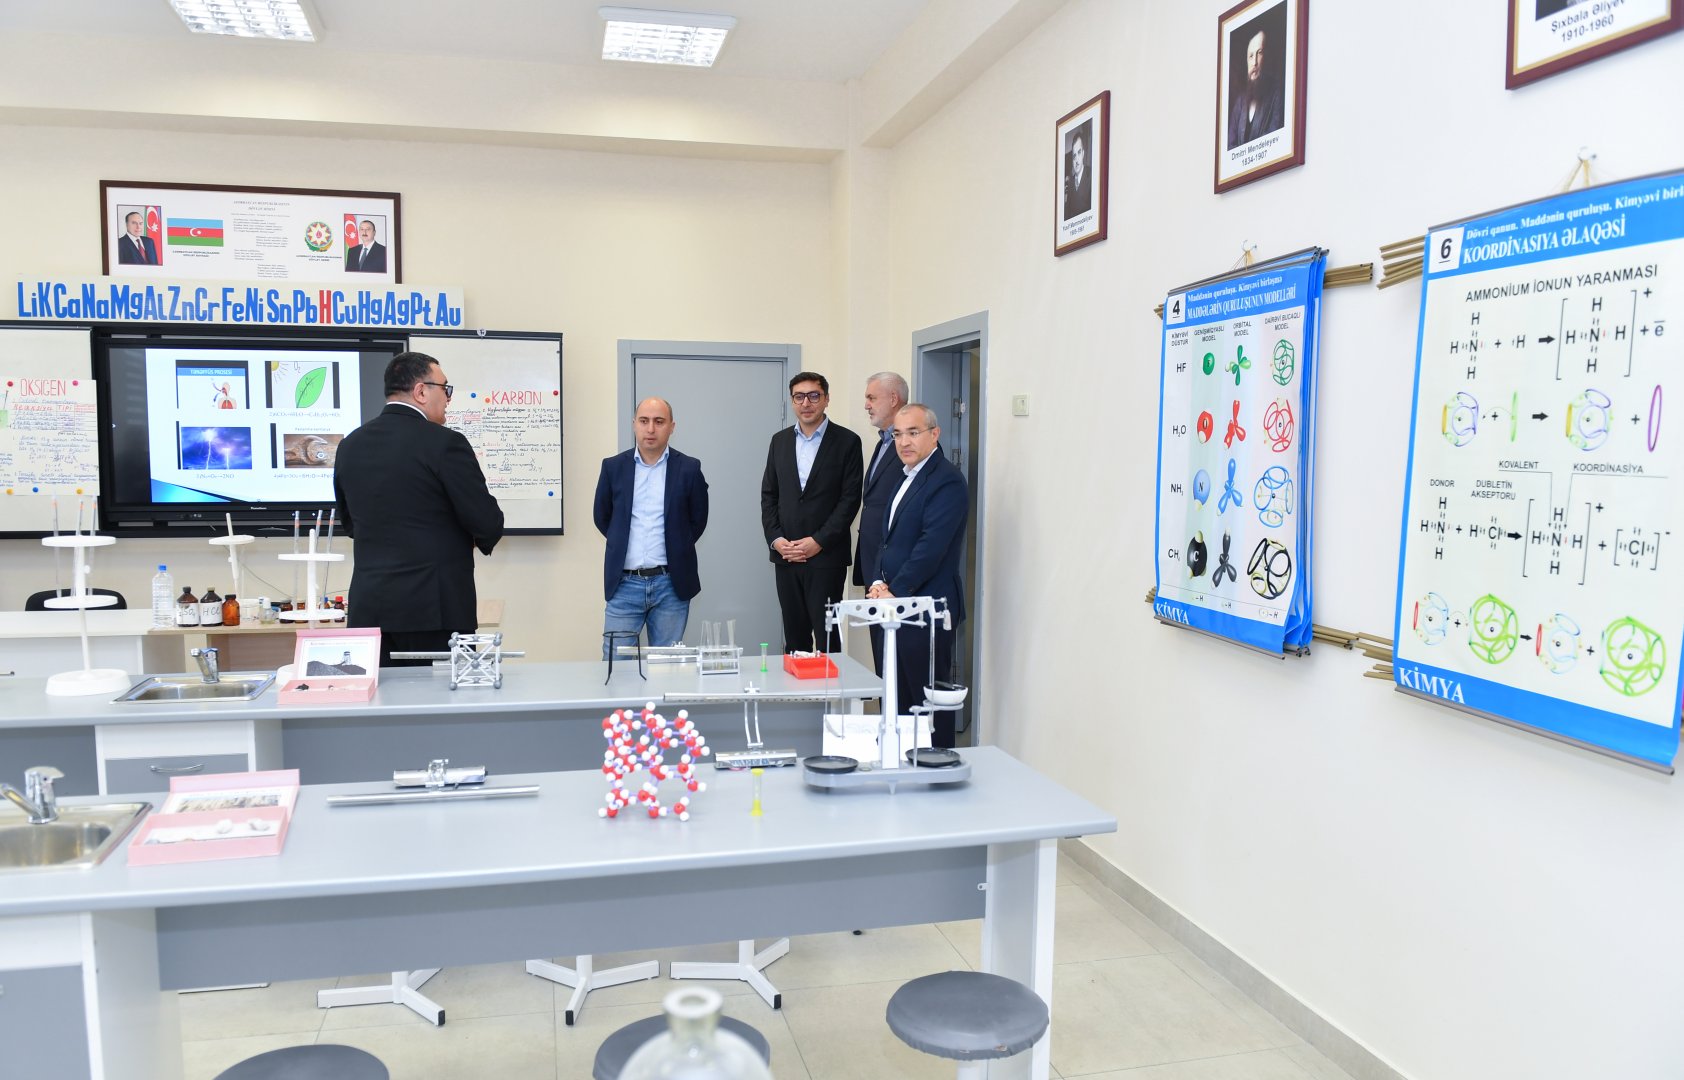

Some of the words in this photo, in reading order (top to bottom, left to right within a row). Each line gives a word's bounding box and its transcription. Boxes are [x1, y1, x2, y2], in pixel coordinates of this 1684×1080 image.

[1561, 14, 1614, 42] 1910-1960
[1231, 146, 1247, 161] Dmitri
[1247, 135, 1280, 155] Mendeleyev
[1241, 149, 1268, 167] 1834-1907
[1466, 226, 1489, 240] Dövri
[1491, 223, 1518, 238] qanun.
[1521, 211, 1565, 229] Maddənin
[1566, 203, 1612, 221] quruluşu.
[1615, 189, 1660, 209] Kimyəvi
[1561, 214, 1626, 248] ƏLAQƏSİ
[1440, 238, 1452, 259] 6
[1465, 282, 1530, 302] AMMONİUM
[1533, 277, 1572, 294] İONUN
[1577, 264, 1658, 288] YARANMASI
[1172, 300, 1180, 315] 4
[1176, 362, 1187, 373] HF
[491, 390, 542, 405] KARBON
[1499, 461, 1539, 470] KOVALENT
[1430, 479, 1455, 488] DONOR
[1476, 479, 1512, 489] DUBLETİN
[1471, 490, 1516, 500] AKSEPTORU
[1156, 601, 1190, 625] KİMYA
[1398, 666, 1465, 705] KİMYA
